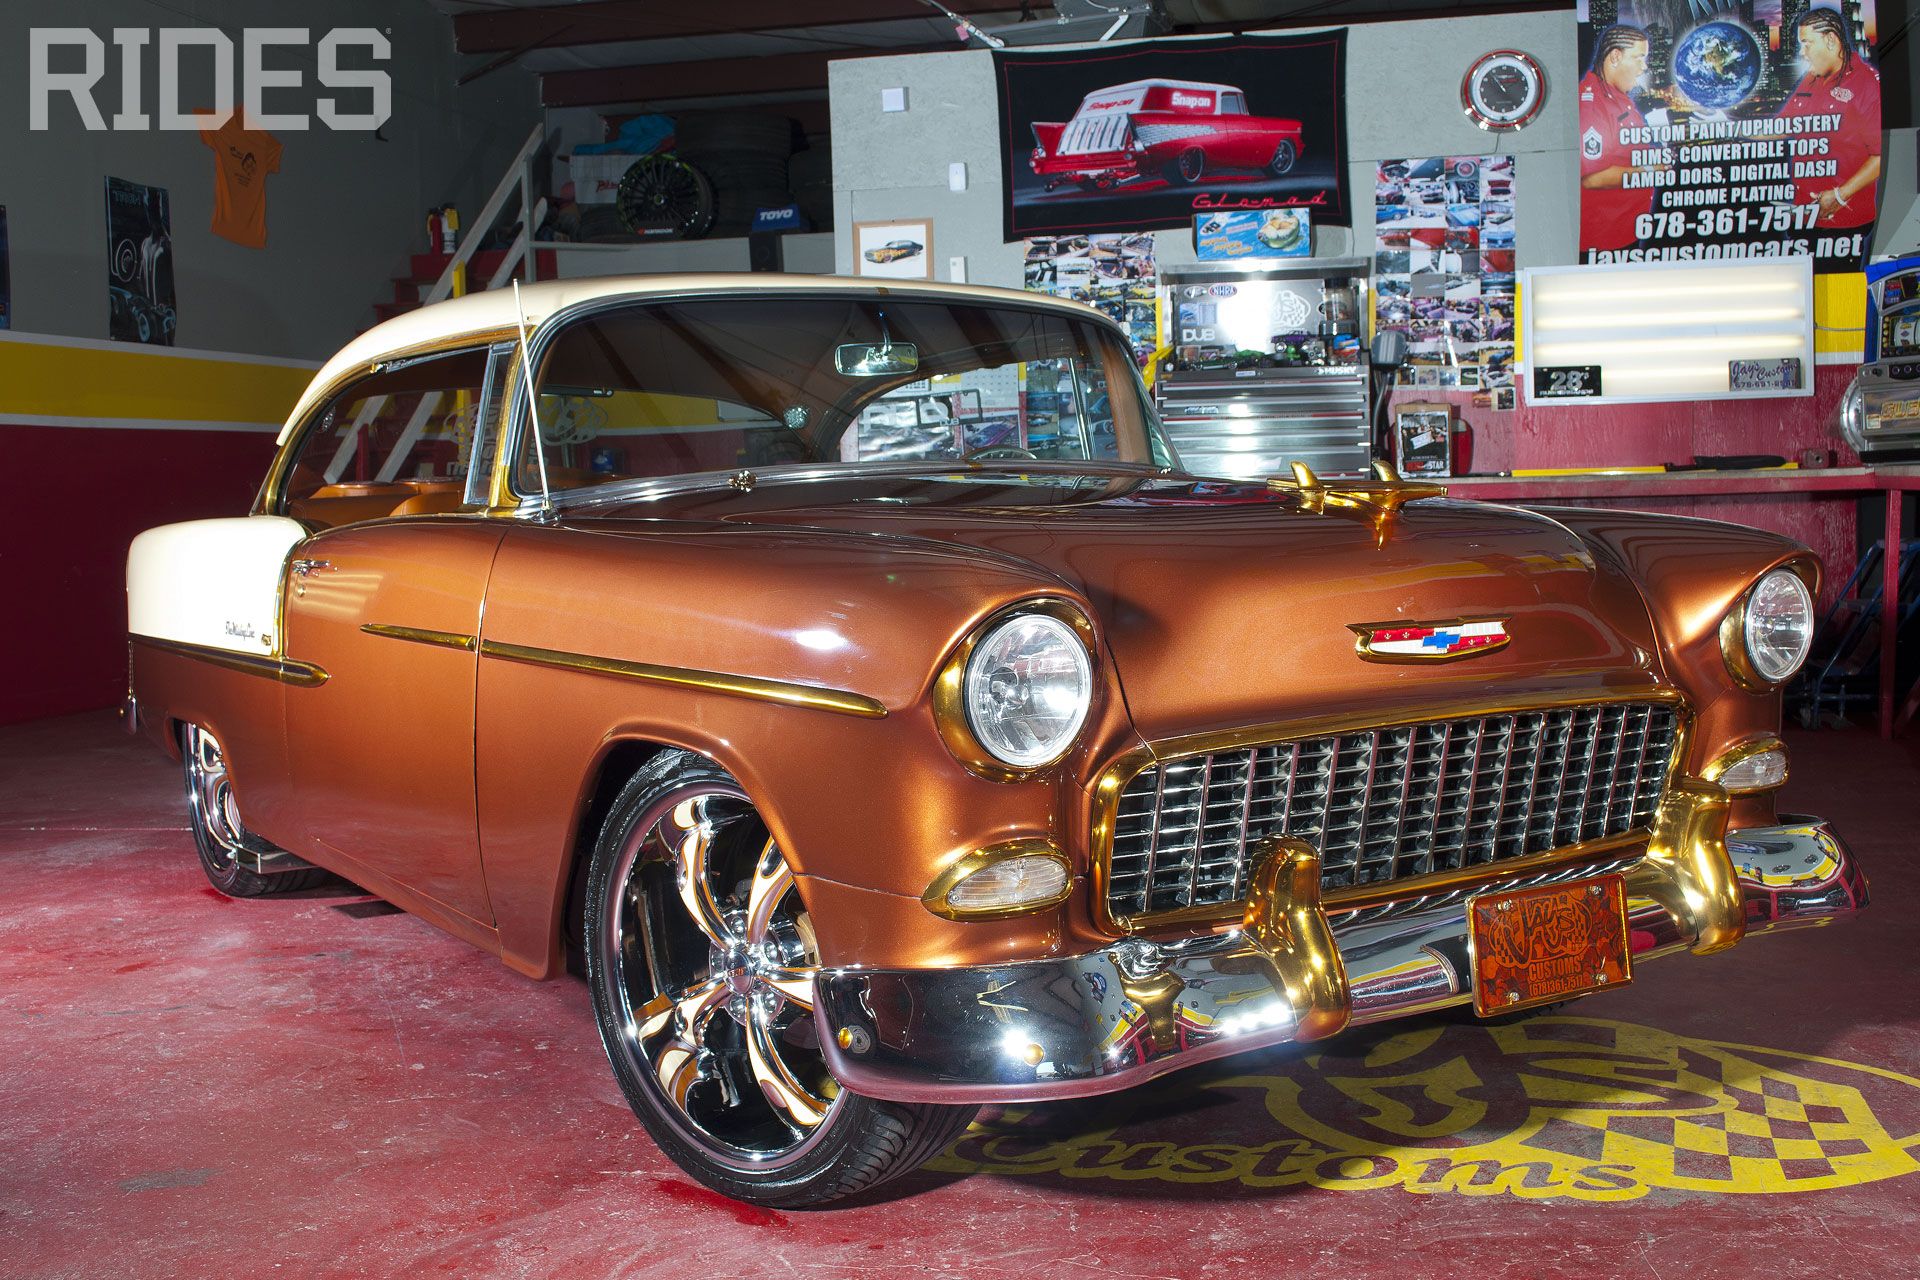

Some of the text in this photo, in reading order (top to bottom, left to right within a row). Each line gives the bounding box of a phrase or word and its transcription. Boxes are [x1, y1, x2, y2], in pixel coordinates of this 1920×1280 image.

[1086, 98, 1135, 112] Snap-on
[1171, 91, 1211, 108] Snap-on
[1619, 114, 1842, 145] CUSTOM PAINT/UPHOLSTERY
[1631, 138, 1829, 167] RIMS, CONVERTIBLE TOPS
[1622, 159, 1837, 189] LAMBO DORS, DIGITAL DASH
[1661, 184, 1795, 208] CHROME PLATING
[759, 208, 793, 222] TOYO
[1635, 203, 1821, 240] 678-361-7517
[1212, 285, 1237, 297] NHRA
[1182, 328, 1216, 342] DUB
[1325, 366, 1357, 375] HUSKY
[1529, 956, 1582, 981] CUSTOMS
